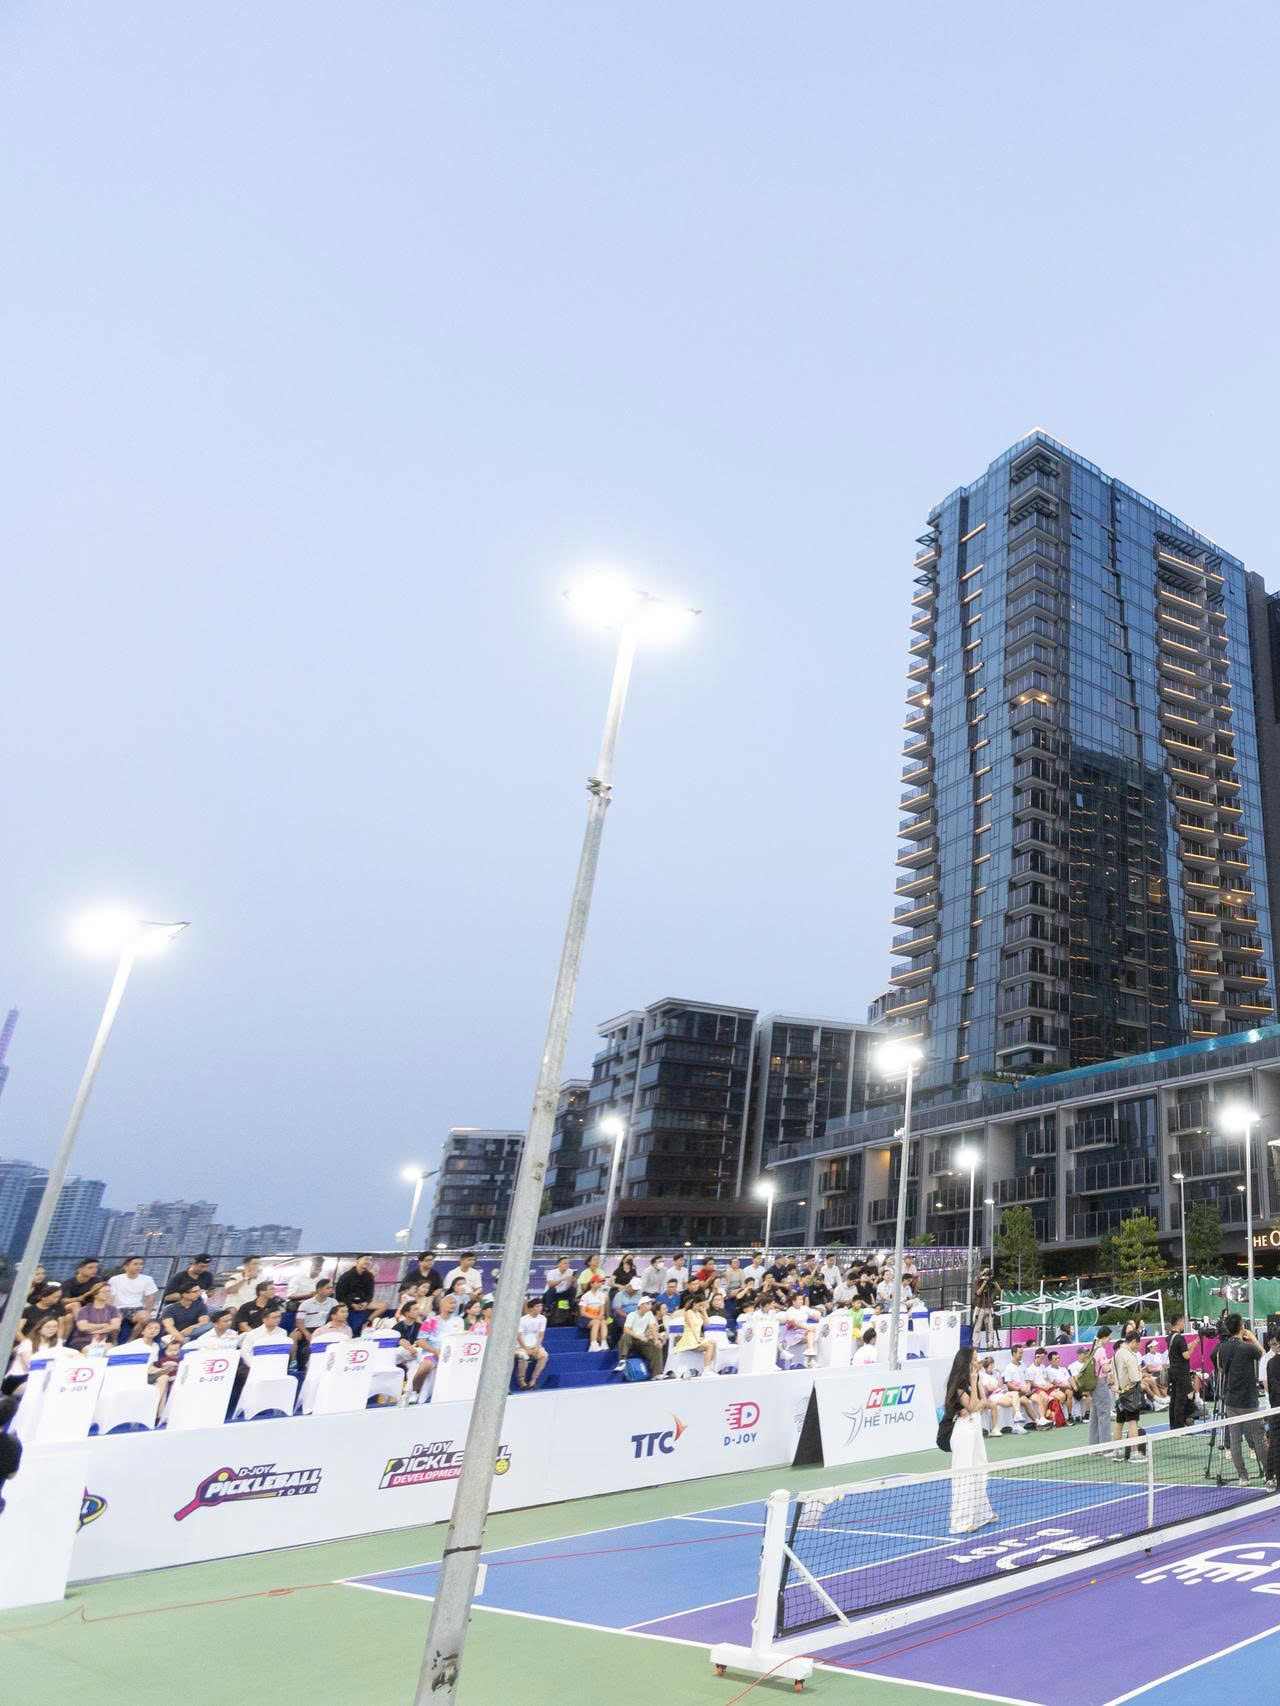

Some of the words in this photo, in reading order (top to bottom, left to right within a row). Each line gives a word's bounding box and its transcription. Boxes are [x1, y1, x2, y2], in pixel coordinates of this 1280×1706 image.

[866, 1384, 915, 1409] HTV
[884, 1410, 914, 1425] THAO
[631, 1431, 675, 1459] TTC
[724, 1433, 757, 1446] D-JOY
[415, 1441, 453, 1456] D-JOY
[239, 1465, 272, 1477] D-JOY
[394, 1467, 462, 1485] DEVELOPMEN
[204, 1469, 322, 1499] PICKLEBALL
[278, 1486, 318, 1498] TOUR
